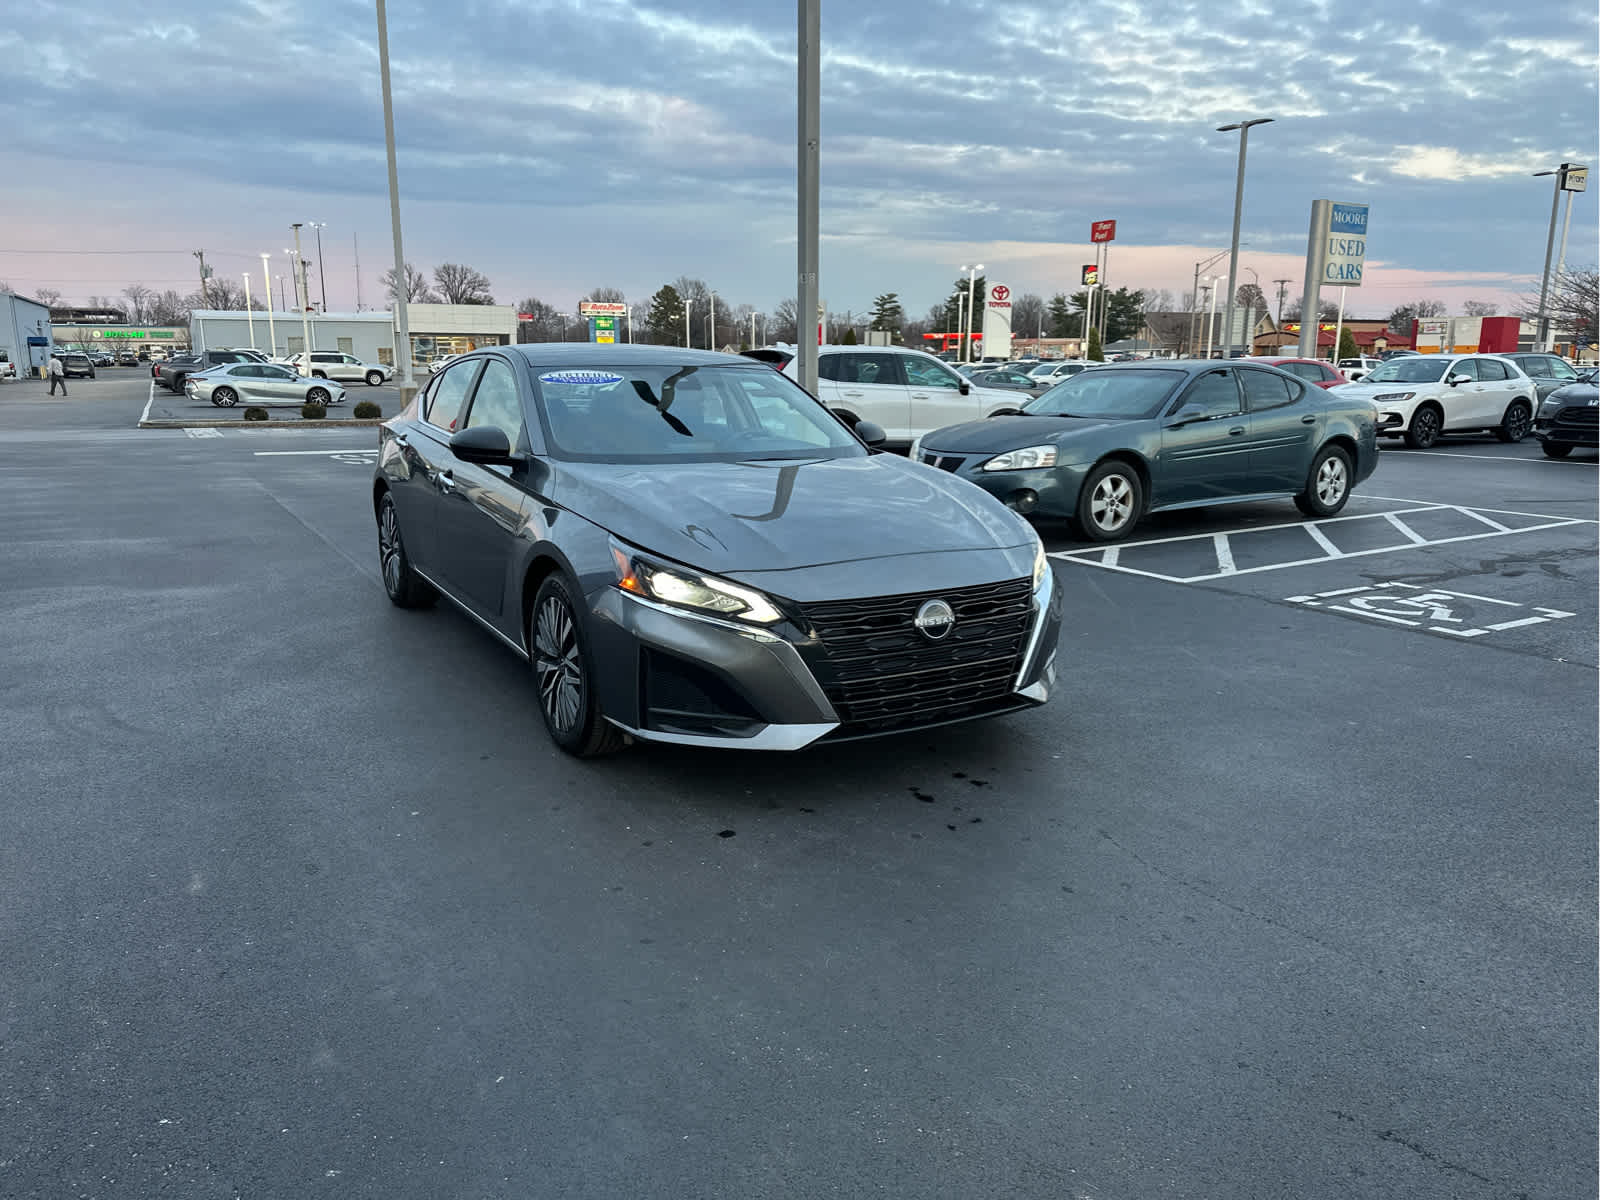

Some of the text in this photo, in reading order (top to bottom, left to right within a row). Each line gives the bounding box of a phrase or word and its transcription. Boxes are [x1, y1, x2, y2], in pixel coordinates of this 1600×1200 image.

[1333, 211, 1367, 225] MOORE
[1329, 238, 1365, 257] USED
[1326, 262, 1362, 281] CARS
[591, 303, 624, 311] AutoZone
[103, 330, 145, 338] DOLLAR
